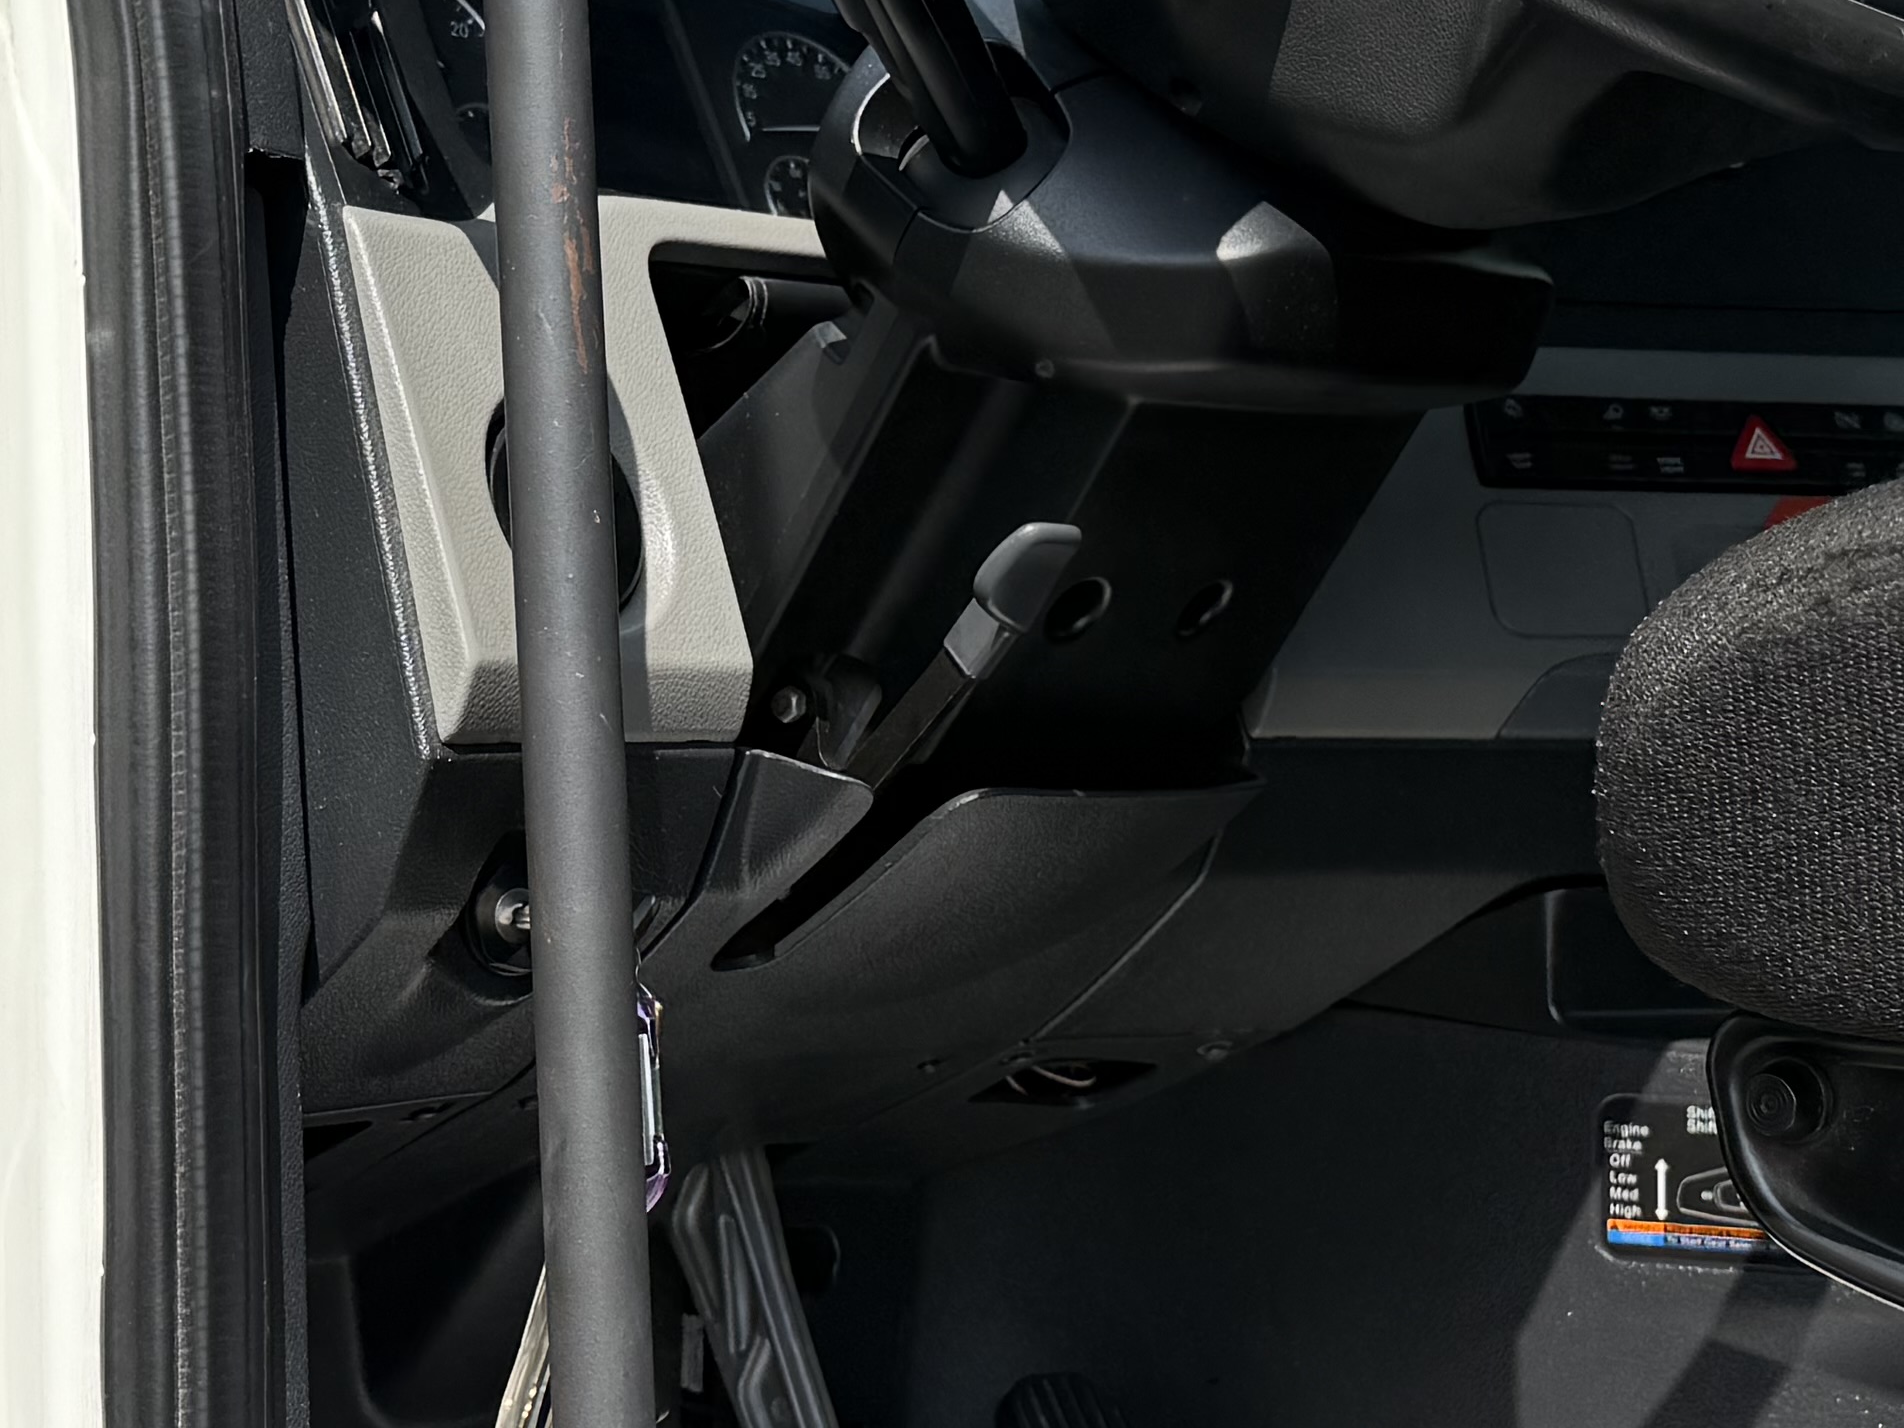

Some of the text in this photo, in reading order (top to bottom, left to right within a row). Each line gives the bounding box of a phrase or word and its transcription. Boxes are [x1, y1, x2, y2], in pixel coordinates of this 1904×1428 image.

[449, 19, 469, 38] 20
[1603, 1120, 1649, 1138] Engine
[1603, 1137, 1642, 1151] Brake
[1609, 1153, 1631, 1168] Off
[1609, 1170, 1637, 1184] Low
[1609, 1186, 1640, 1201] Med
[1609, 1202, 1641, 1219] High
